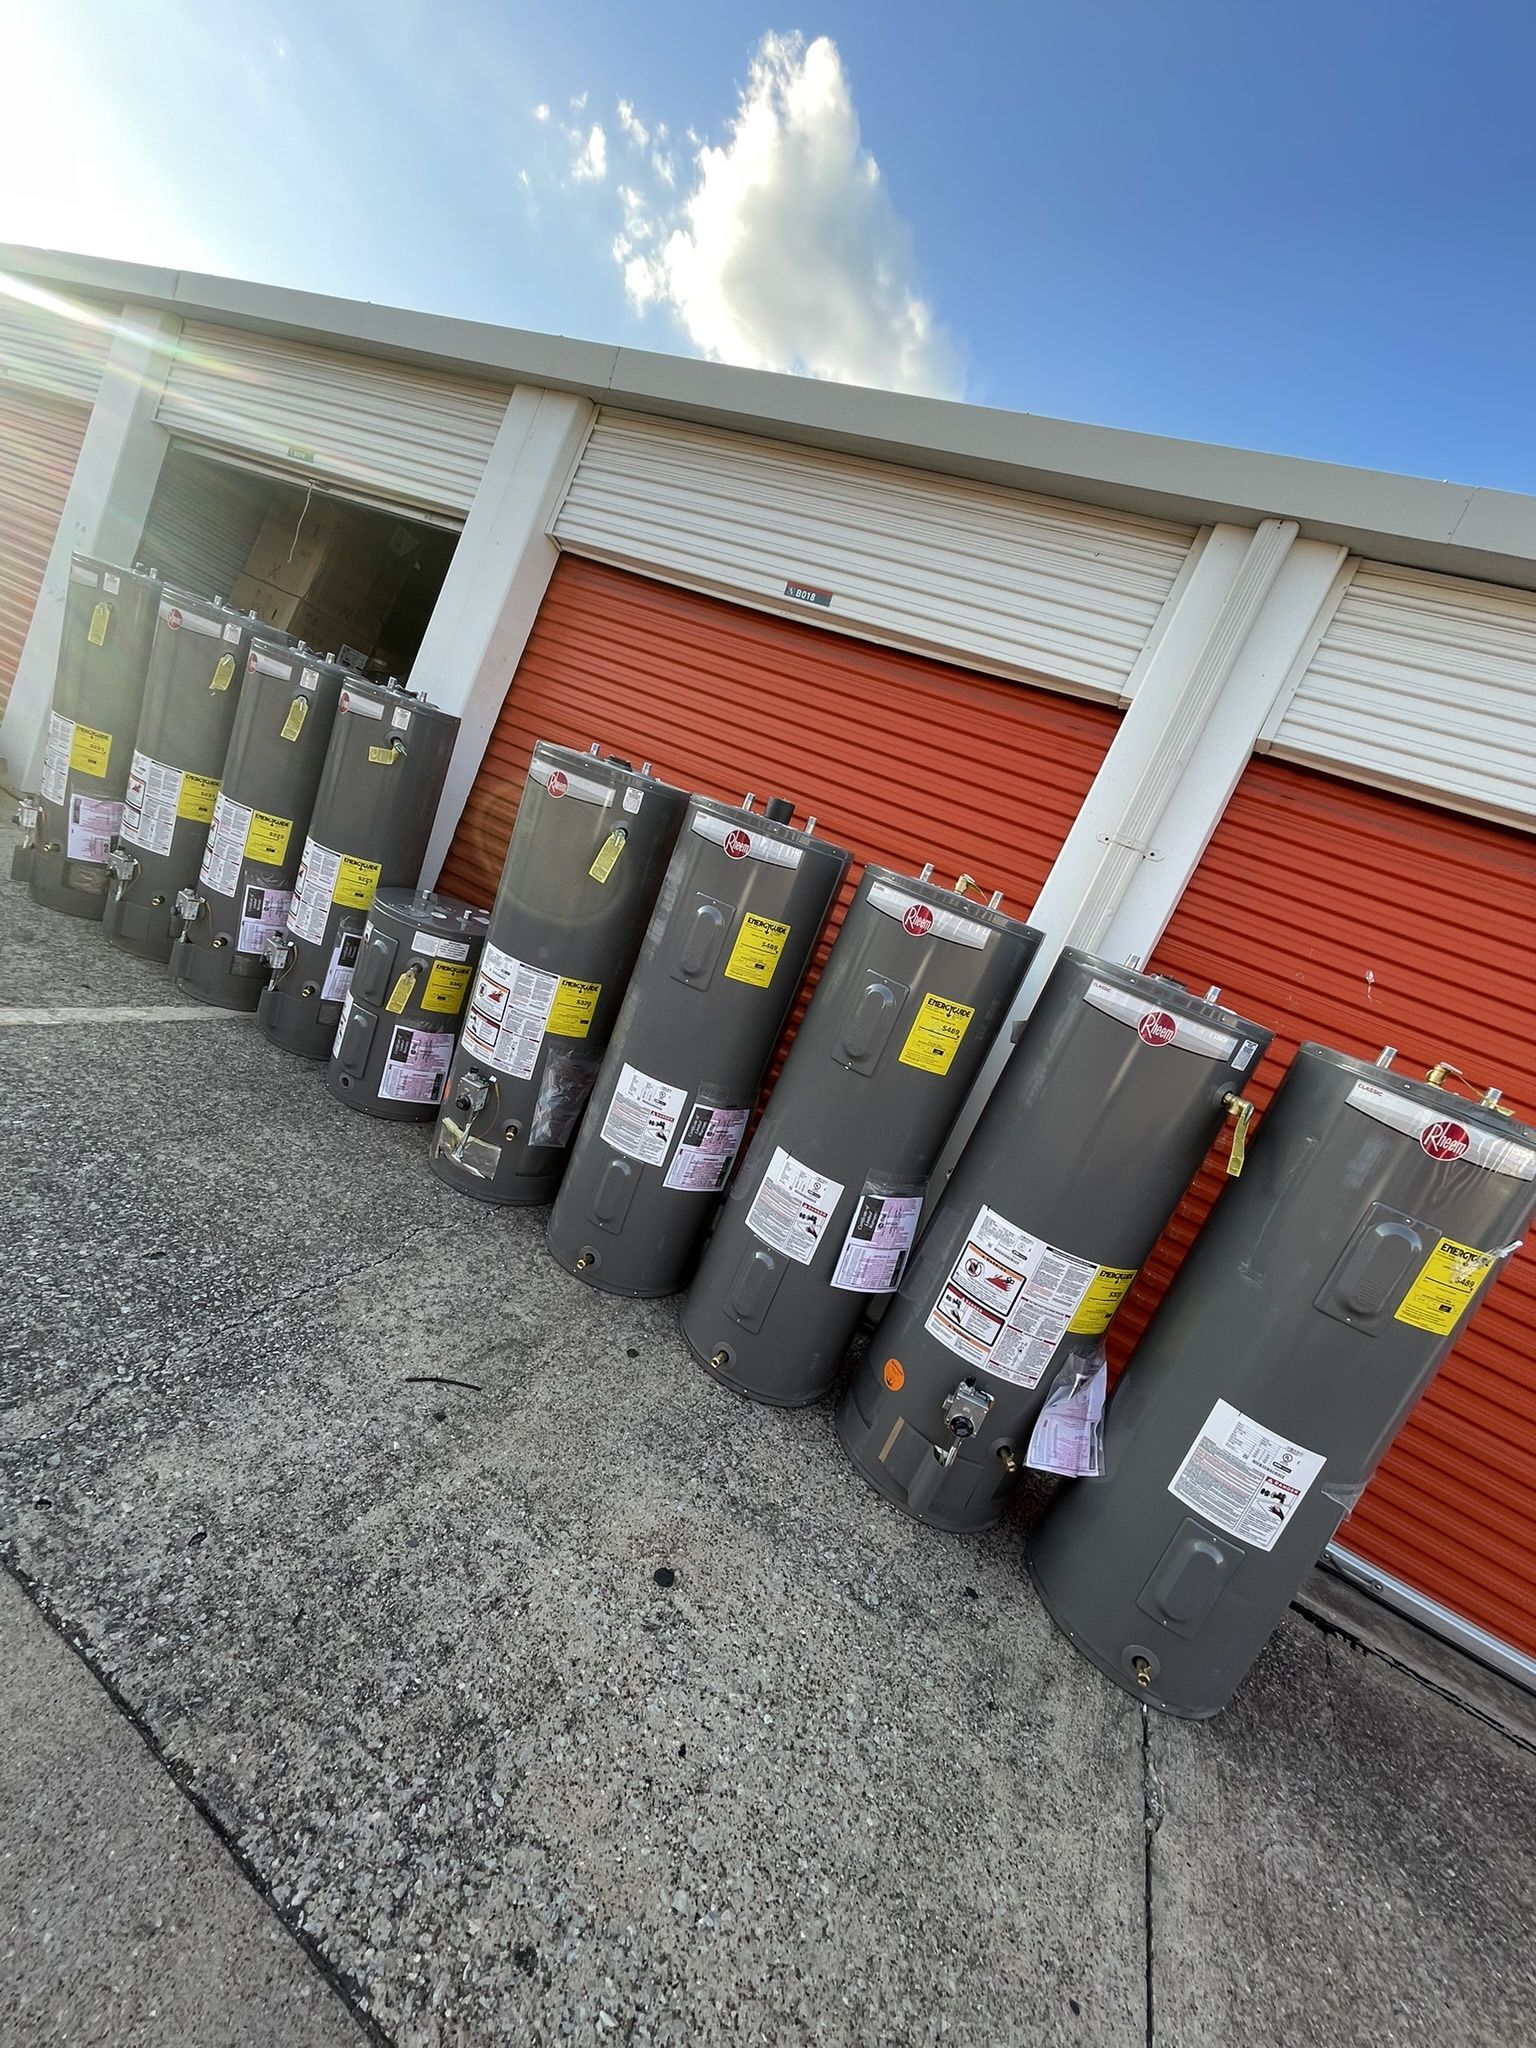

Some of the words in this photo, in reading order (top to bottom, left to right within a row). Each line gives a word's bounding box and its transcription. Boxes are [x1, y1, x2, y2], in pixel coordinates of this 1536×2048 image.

[795, 589, 816, 602] B018
[725, 830, 750, 853] Rheem
[748, 917, 787, 934] ENERGYGUIDE
[904, 905, 931, 930] Rheem
[927, 998, 971, 1018] ENERGYGUIDE
[1141, 1012, 1174, 1042] Rheem
[1357, 1083, 1383, 1097] CLASSIC
[1424, 1122, 1467, 1155] Rheem
[1273, 1480, 1300, 1497] DANGER
